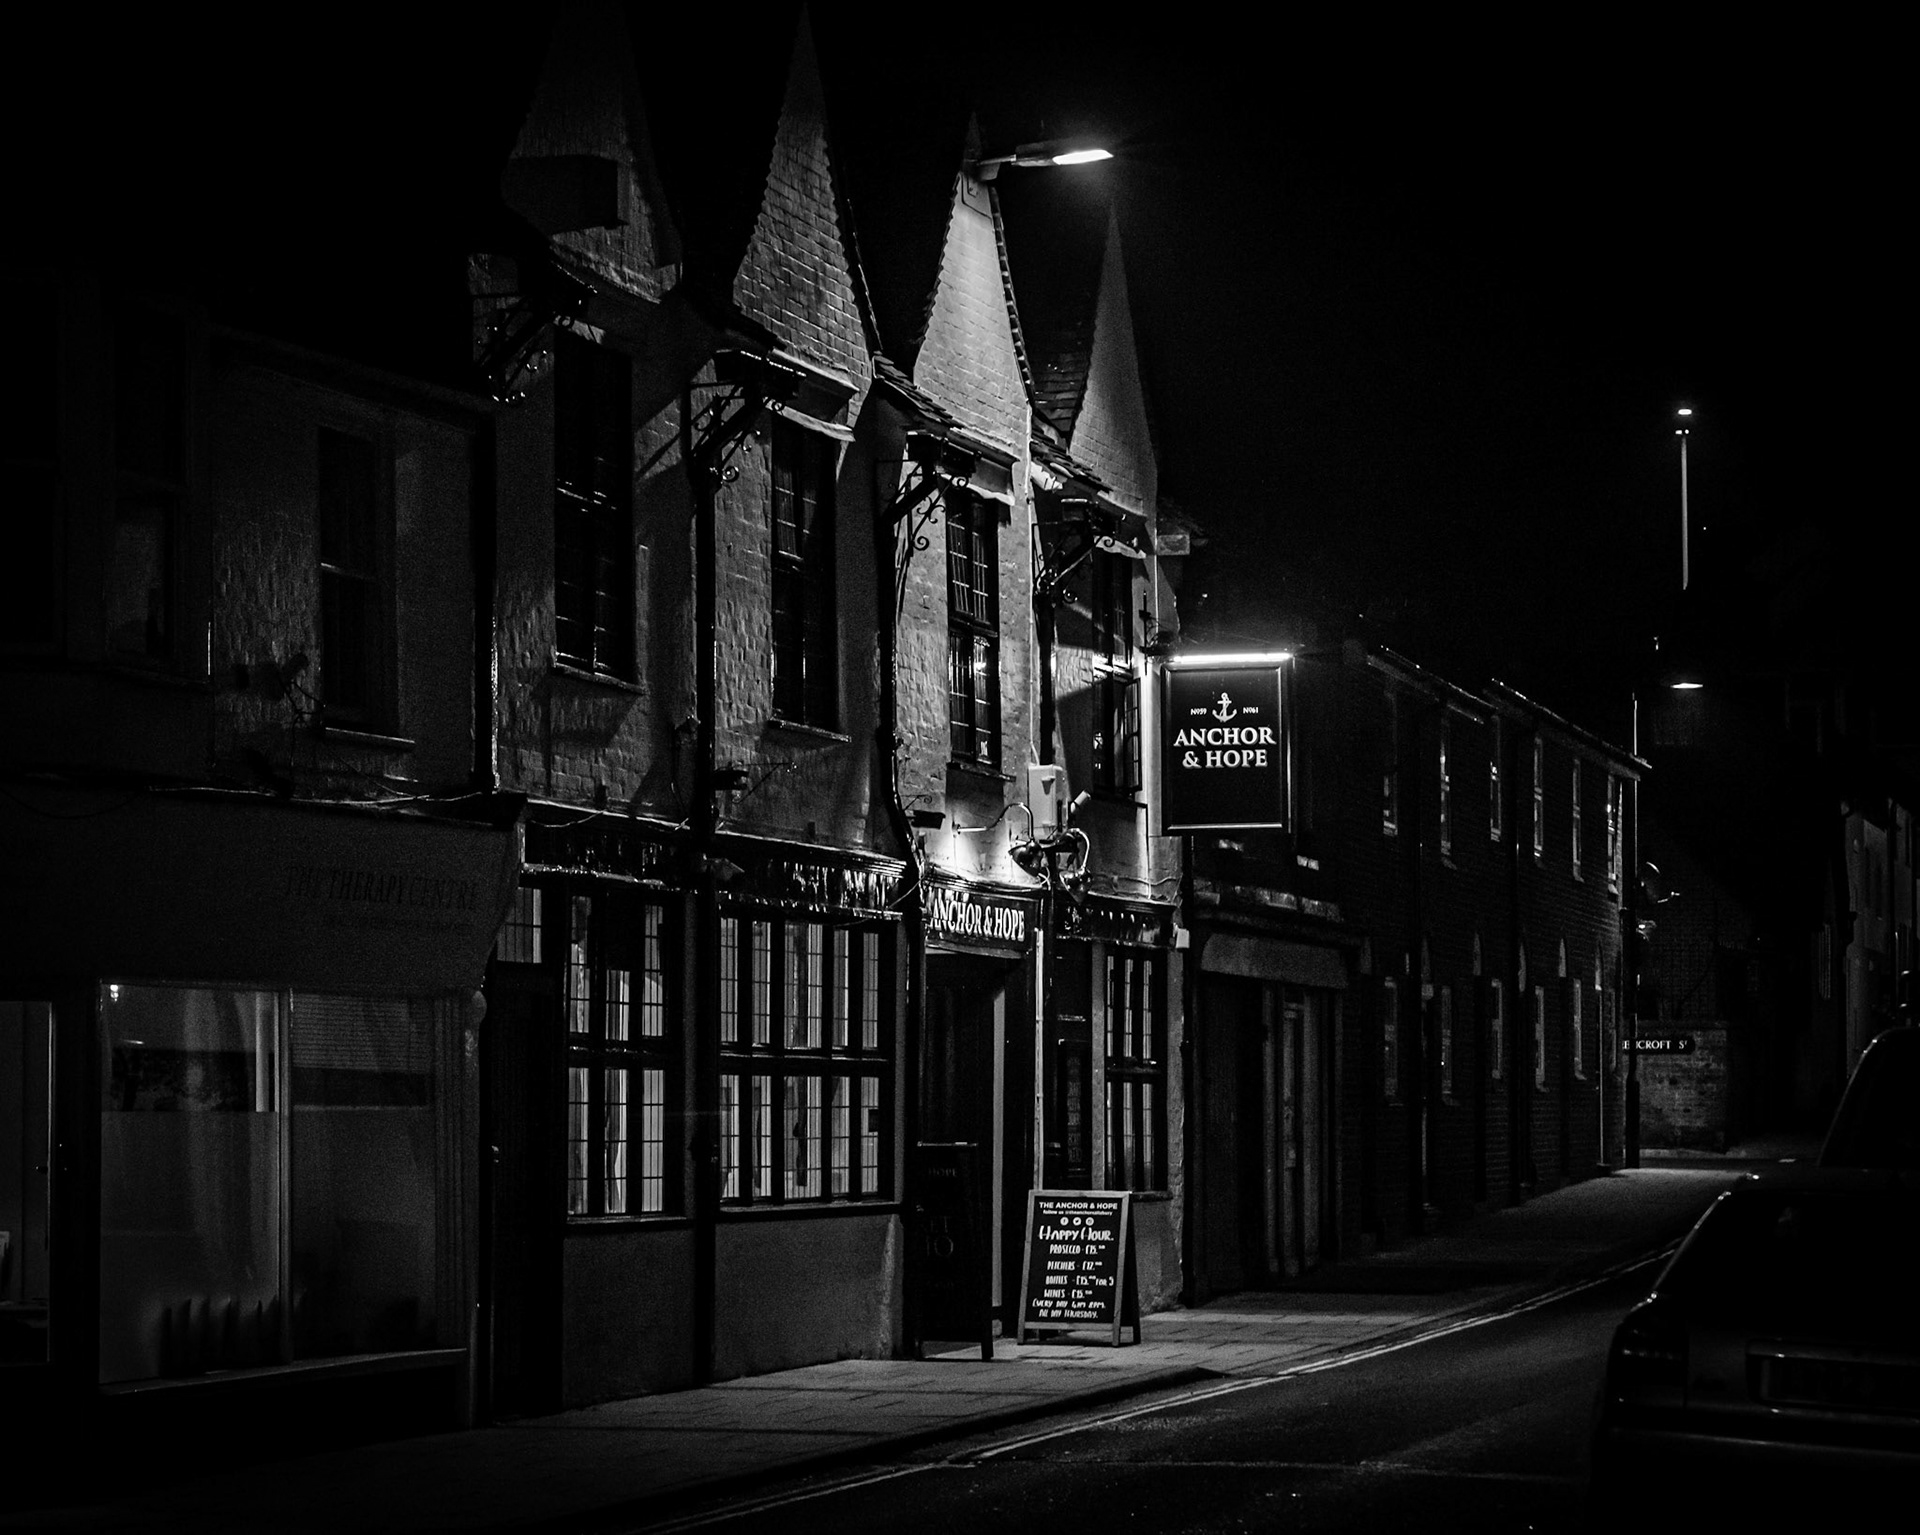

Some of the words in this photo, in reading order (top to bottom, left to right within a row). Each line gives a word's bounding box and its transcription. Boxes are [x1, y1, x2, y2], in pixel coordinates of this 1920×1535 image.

[1173, 727, 1277, 747] ANCHOR
[1182, 750, 1202, 769] &
[1205, 749, 1268, 768] HOPE
[328, 869, 407, 904] THERAPY
[929, 897, 982, 935] ANCHOR
[983, 905, 993, 938] &
[993, 906, 1025, 942] HOPE
[1039, 1201, 1054, 1209] THE
[1055, 1201, 1088, 1209] ANCHOR
[1096, 1202, 1118, 1210] HOPE
[1044, 1288, 1066, 1298] WINES
